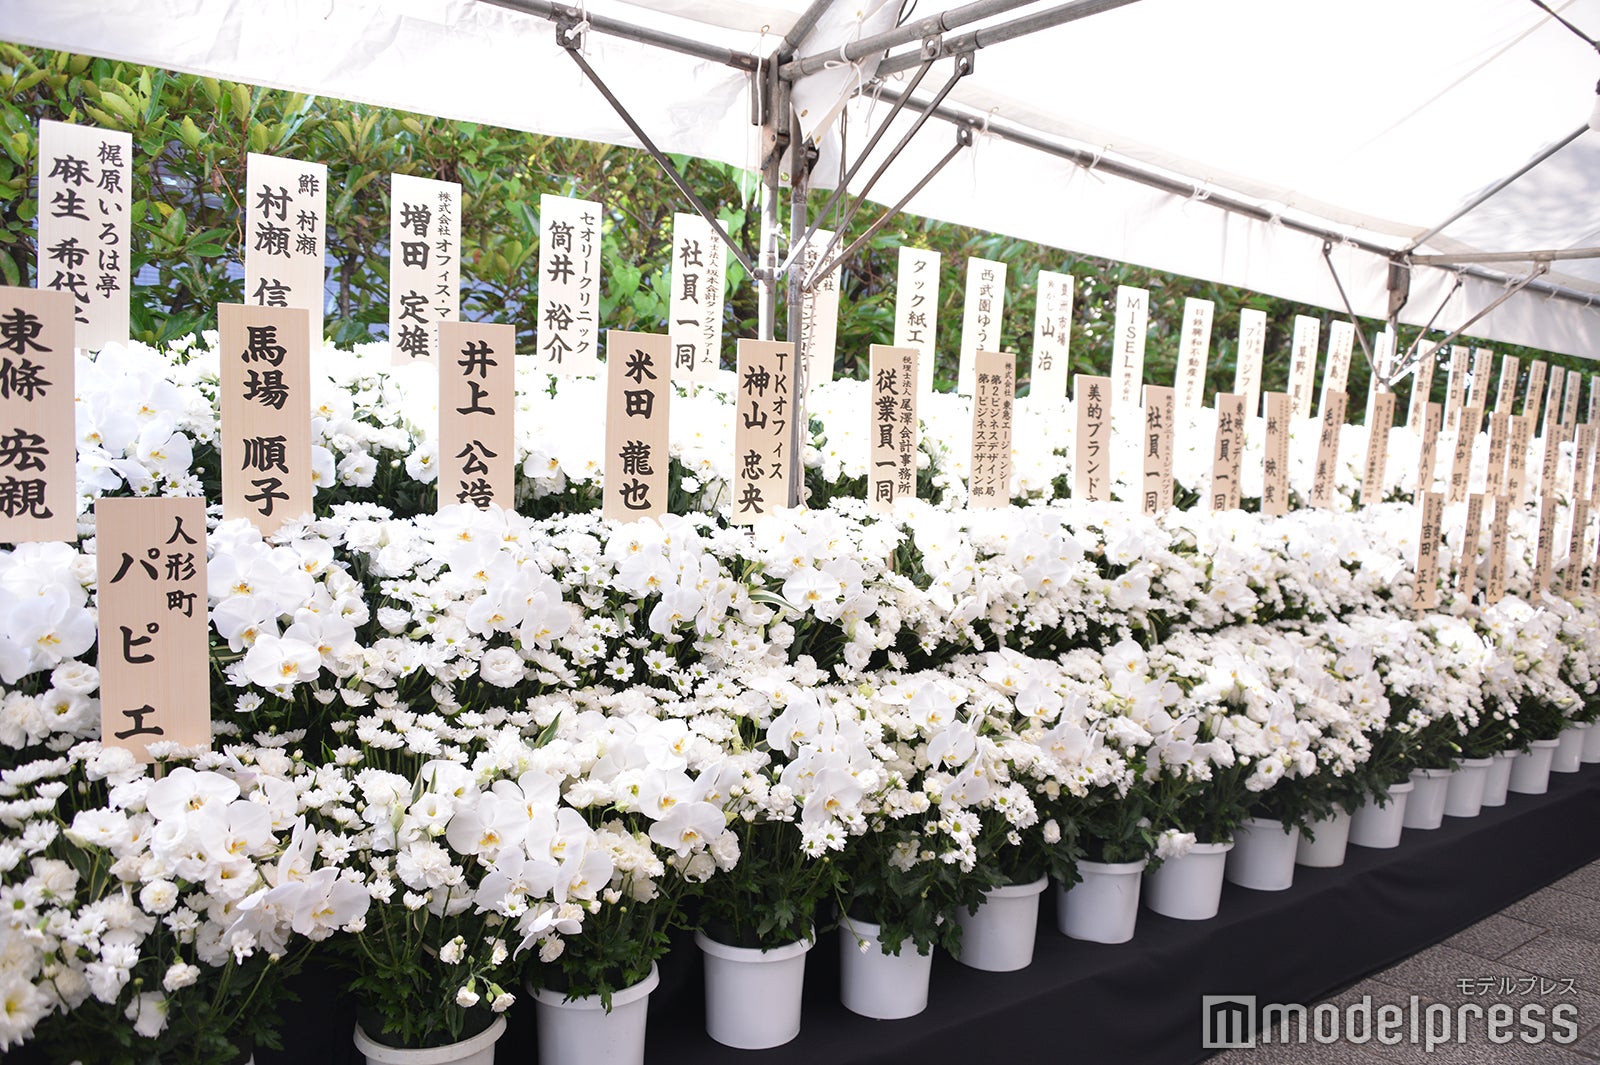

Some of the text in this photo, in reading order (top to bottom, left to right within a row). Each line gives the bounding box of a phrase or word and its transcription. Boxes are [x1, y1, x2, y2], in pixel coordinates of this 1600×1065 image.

[48, 154, 95, 222] 麻生
[96, 140, 125, 299] 梶原いろは亭
[254, 184, 294, 259] 村瀬
[295, 209, 319, 258] 村瀬
[397, 202, 432, 359] 増田 定雄
[543, 220, 576, 364] 筒井 裕介
[576, 212, 596, 354] セオリークリニック
[675, 238, 704, 372] 社員一同
[0, 308, 54, 520] 東條 宏親
[241, 325, 290, 517] 馬場 順子
[456, 340, 498, 416] 井上
[618, 349, 658, 511] 米田 龍也
[738, 365, 771, 514] 神山 忠央
[875, 368, 899, 505] 従業員一同
[1144, 405, 1163, 515] 社員一同
[1213, 412, 1234, 511] 社員一同
[164, 515, 198, 619] 人形町
[109, 547, 165, 741] パピエ
